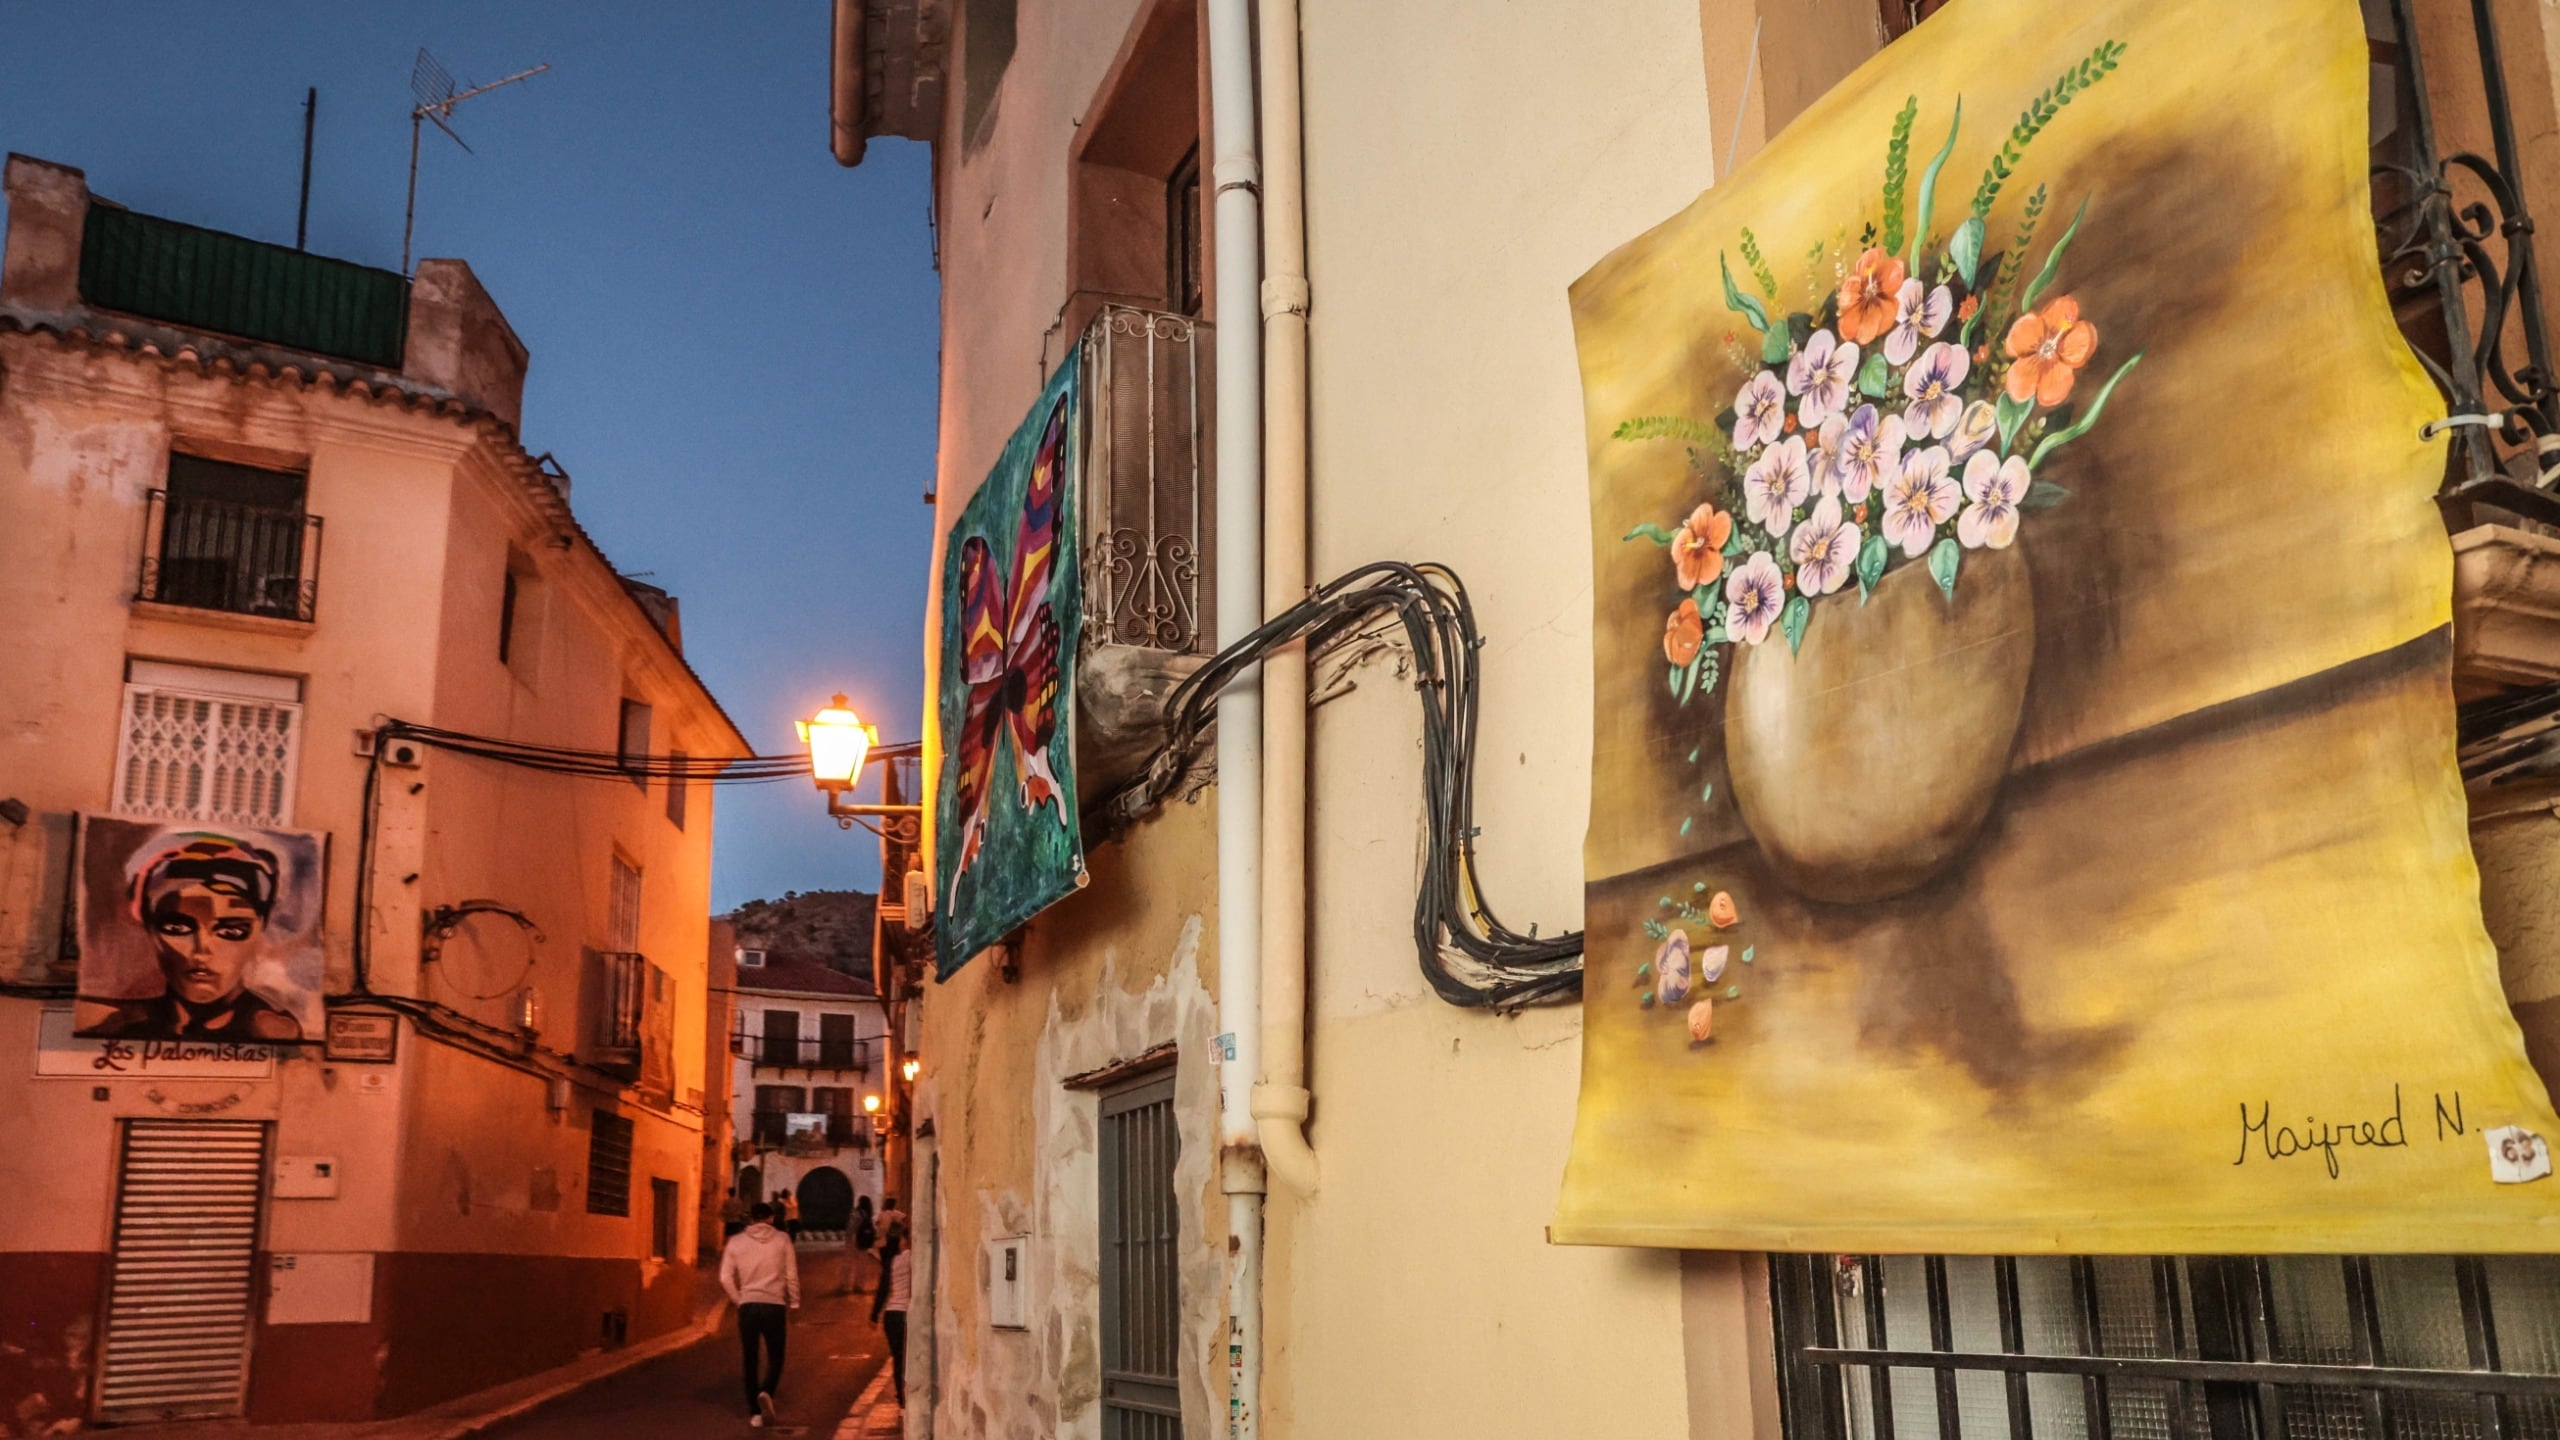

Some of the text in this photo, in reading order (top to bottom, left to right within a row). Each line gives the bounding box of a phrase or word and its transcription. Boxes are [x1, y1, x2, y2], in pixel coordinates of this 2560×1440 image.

[93, 1040, 135, 1071] Los
[2434, 1090, 2482, 1142] N.
[2500, 1132, 2537, 1164] 63
